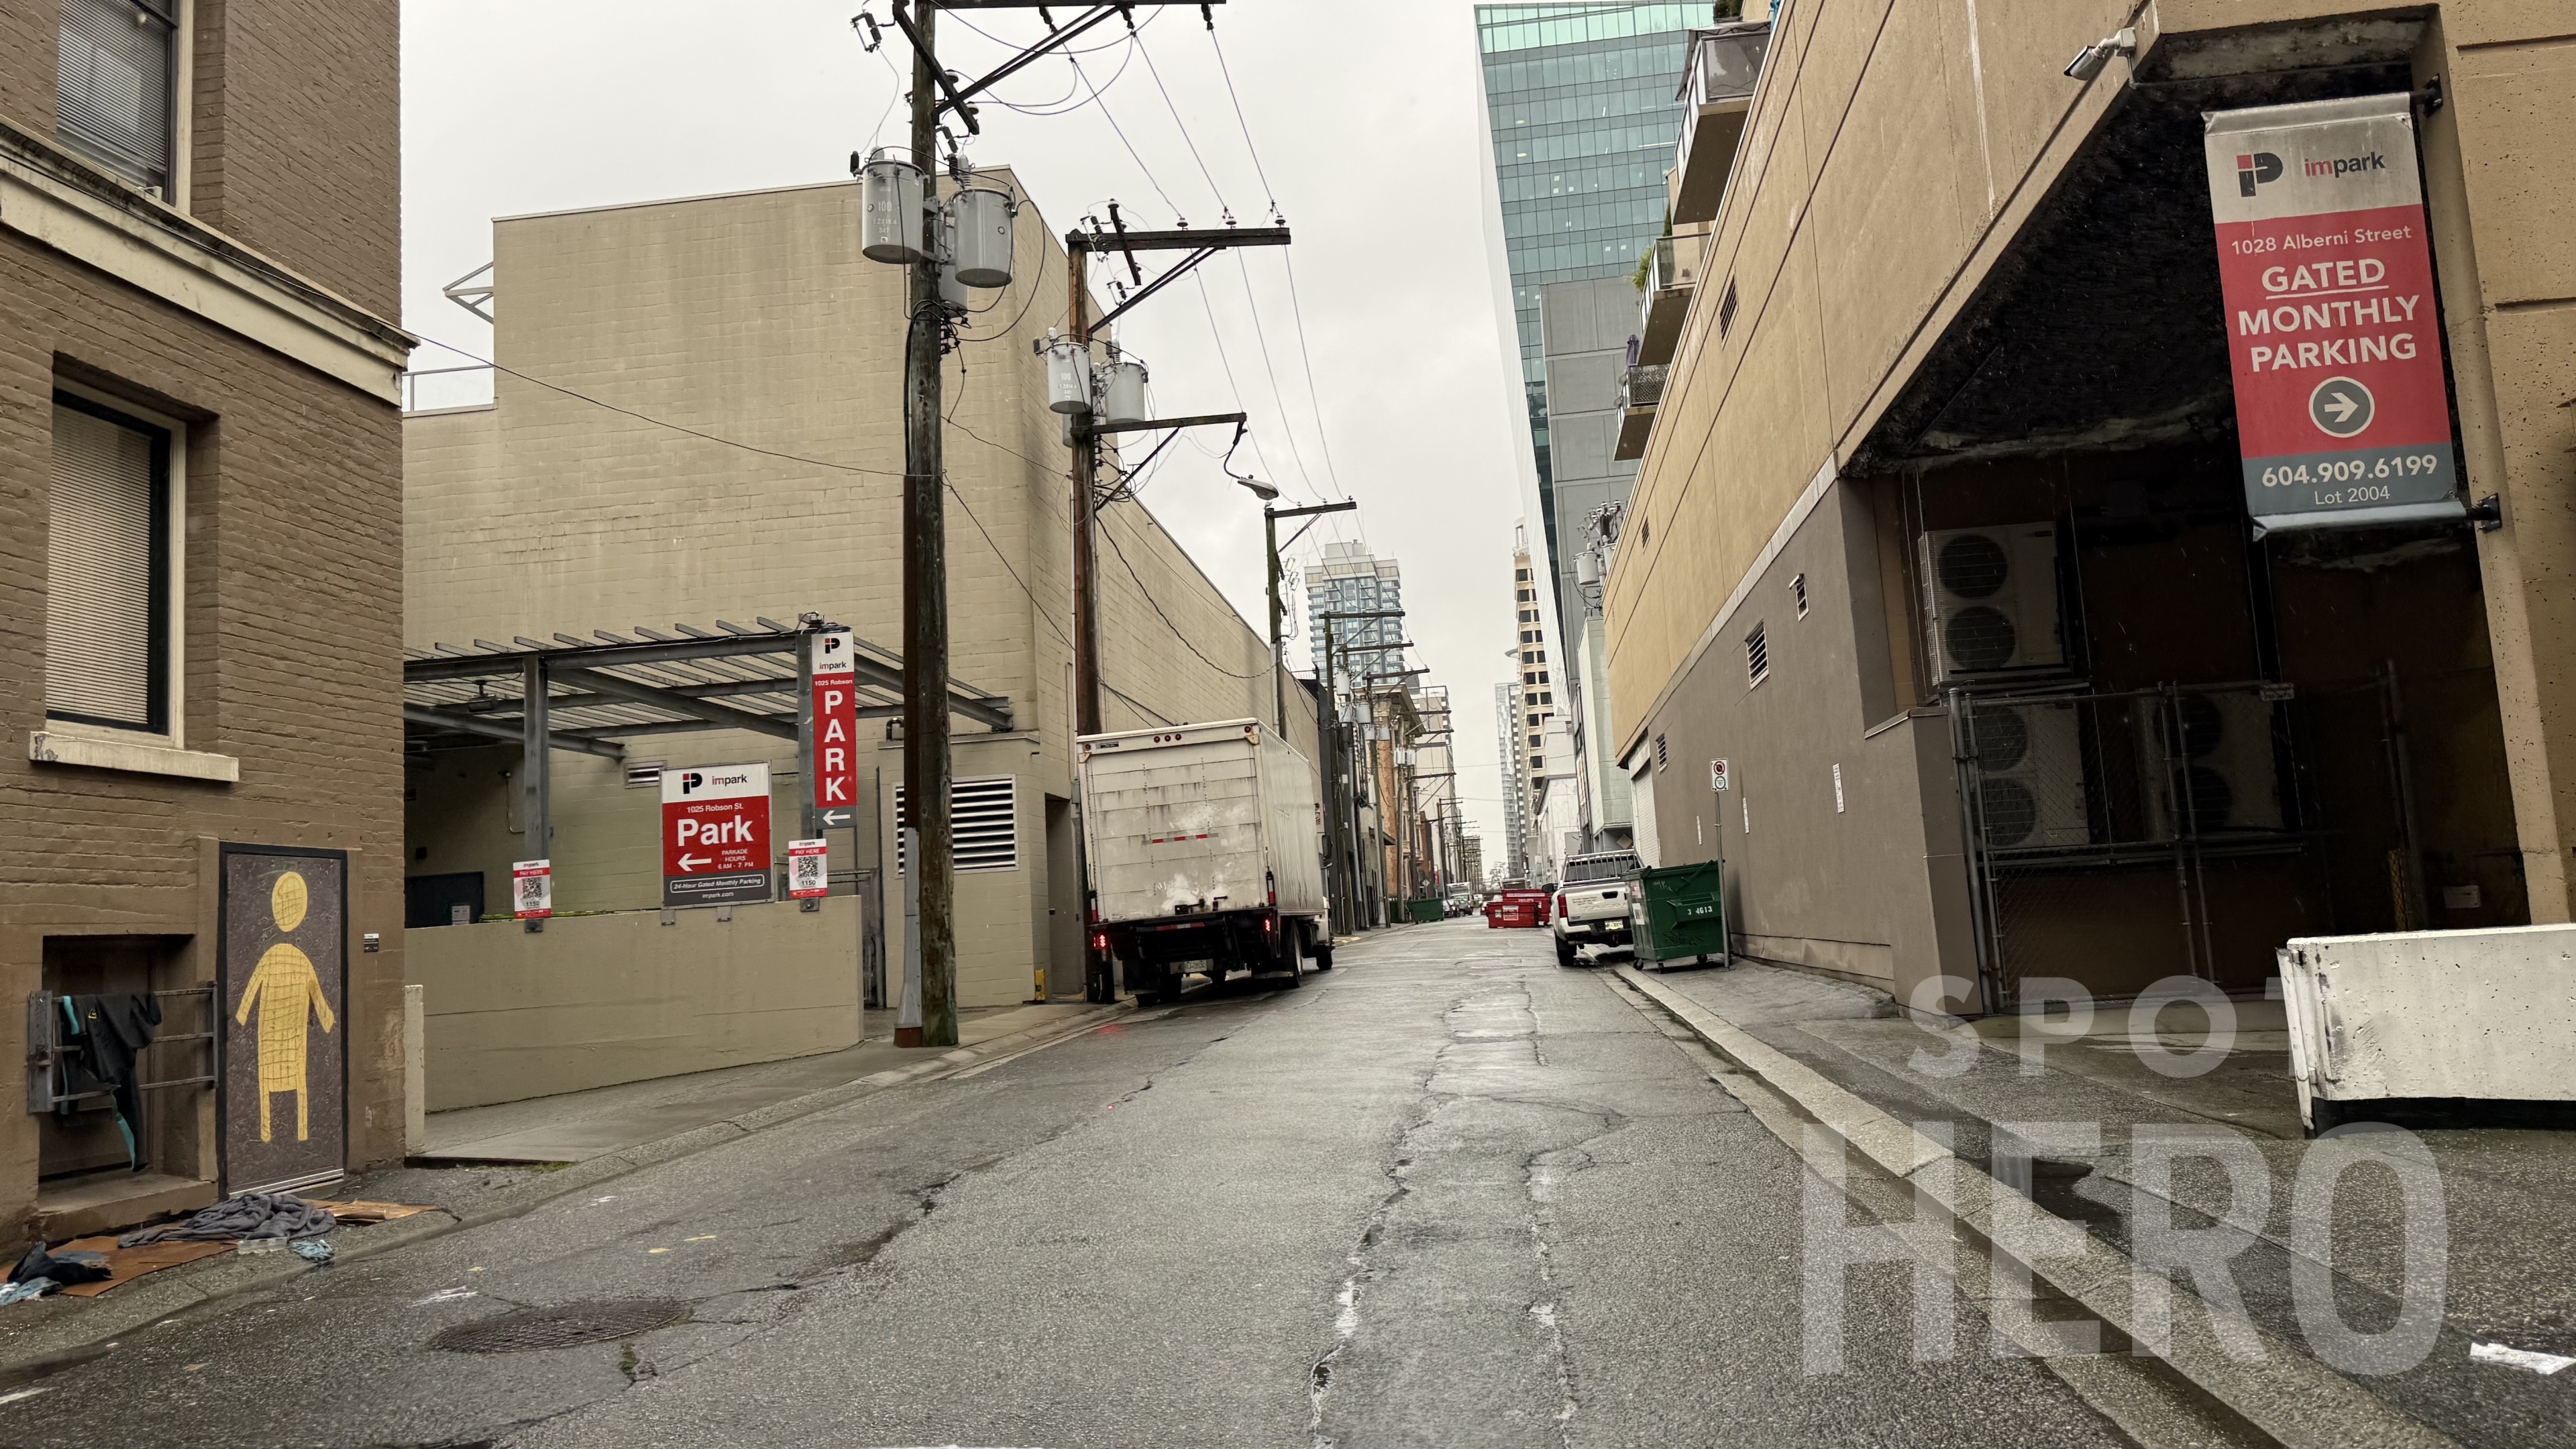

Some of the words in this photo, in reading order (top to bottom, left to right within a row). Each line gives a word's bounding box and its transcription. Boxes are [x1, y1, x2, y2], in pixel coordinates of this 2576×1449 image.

[2304, 152, 2385, 178] impark
[2231, 237, 2277, 256] 1028
[2284, 231, 2349, 251] Alberni
[2355, 225, 2412, 244] Street
[2261, 258, 2385, 292] GATED
[2238, 295, 2420, 336] MONTHLY
[2251, 333, 2416, 373] PARKING
[2261, 454, 2438, 488] 604.909.6199
[2314, 489, 2345, 505] Lot
[2348, 486, 2391, 504] 2004
[819, 661, 847, 670] impark
[824, 690, 847, 802] PARK
[712, 774, 747, 787] impark
[705, 804, 733, 812] Robson
[678, 814, 754, 847] Park
[702, 892, 734, 900] impark.com
